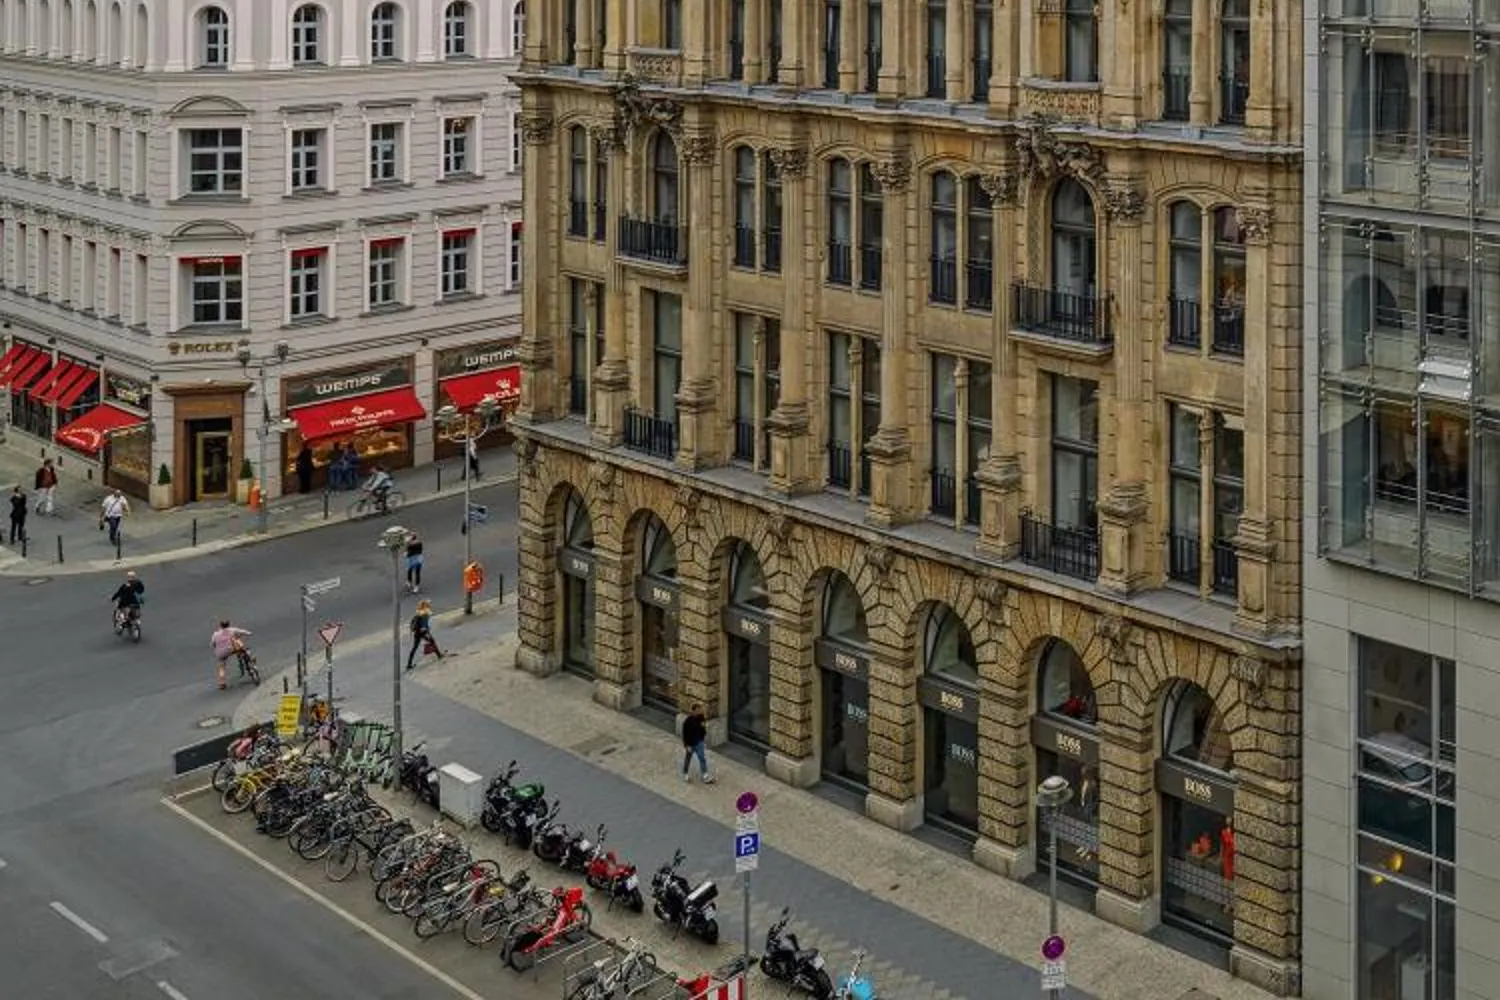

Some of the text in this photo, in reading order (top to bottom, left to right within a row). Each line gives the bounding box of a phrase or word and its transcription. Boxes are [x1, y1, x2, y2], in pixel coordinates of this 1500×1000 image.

[184, 342, 235, 354] ROLEX
[314, 374, 382, 395] WEMPE
[835, 653, 857, 670] BOSS
[941, 691, 965, 711] BOSS
[1056, 732, 1082, 752] BOSS
[1184, 777, 1213, 799] BOSS
[741, 836, 753, 855] P
